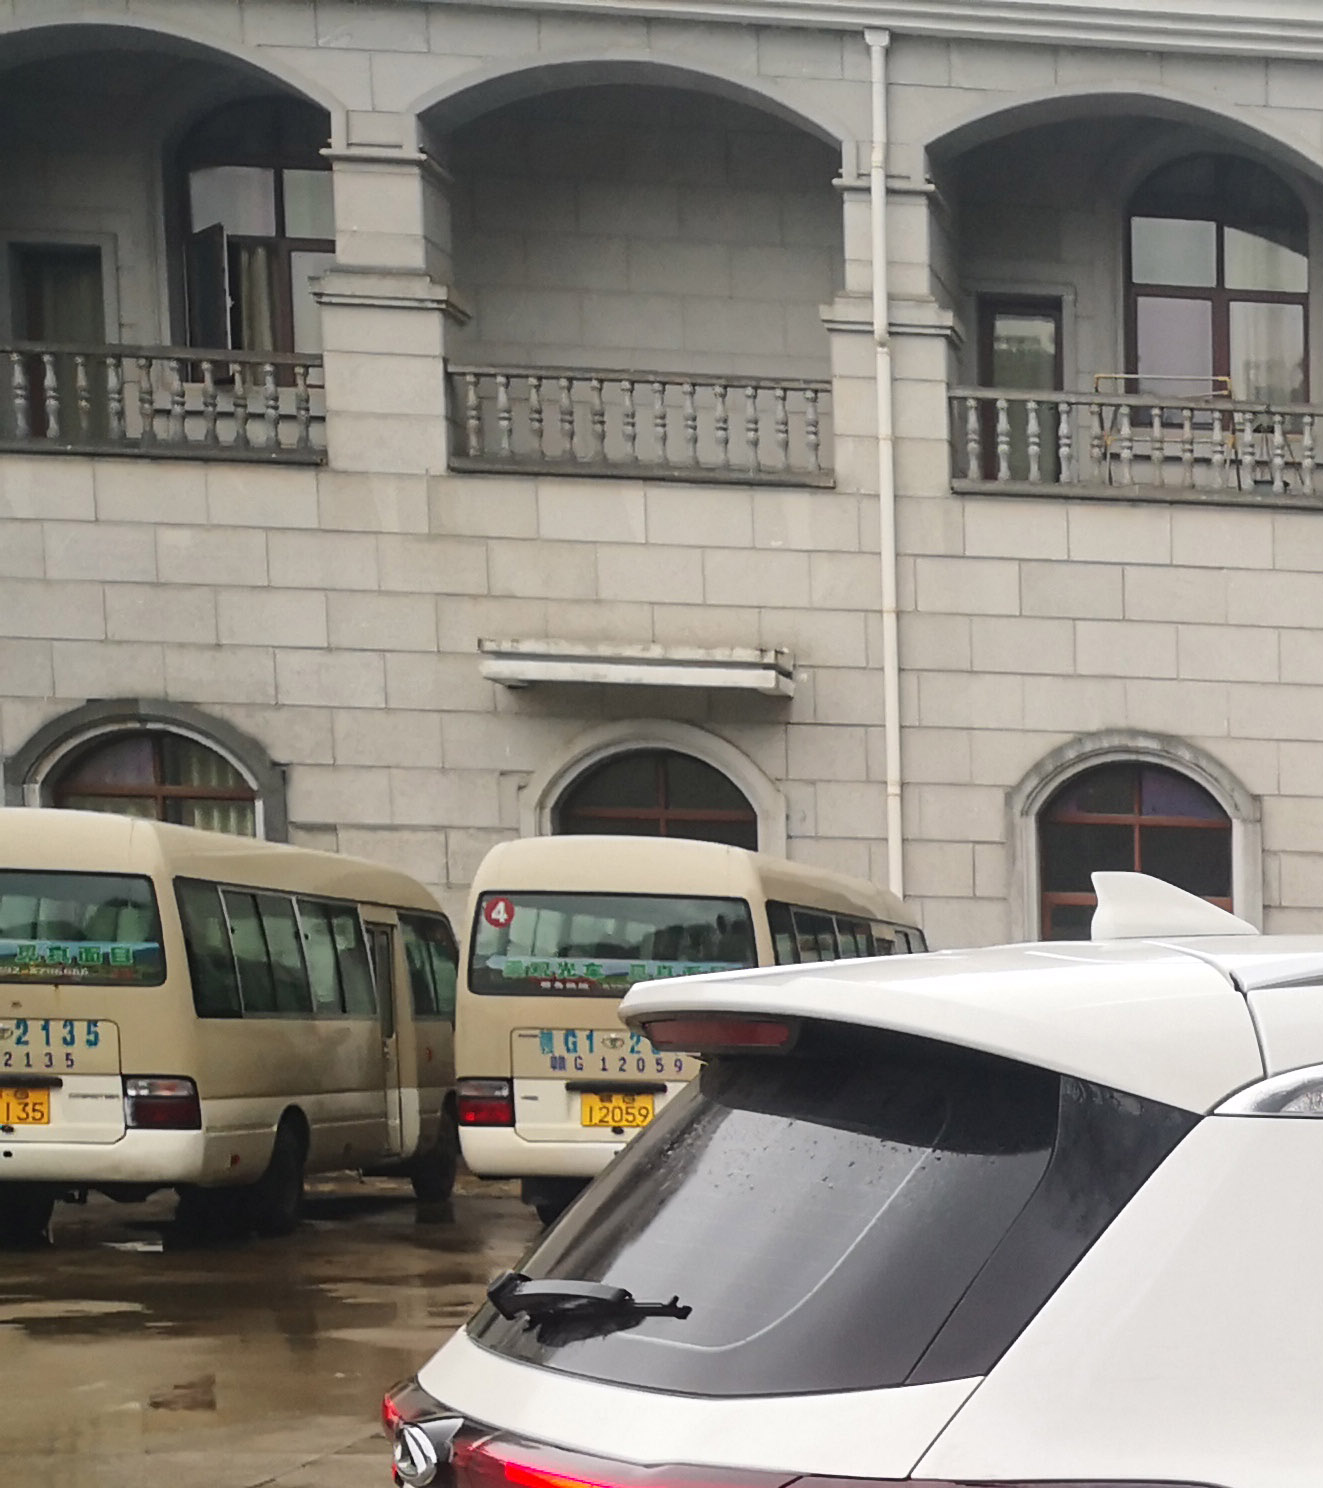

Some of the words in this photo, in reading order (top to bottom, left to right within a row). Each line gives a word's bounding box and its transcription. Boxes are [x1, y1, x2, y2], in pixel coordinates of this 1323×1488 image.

[490, 902, 508, 922] 4
[14, 1019, 100, 1047] 2135
[3, 1051, 75, 1068] 2135
[588, 1105, 650, 1124] 12059
